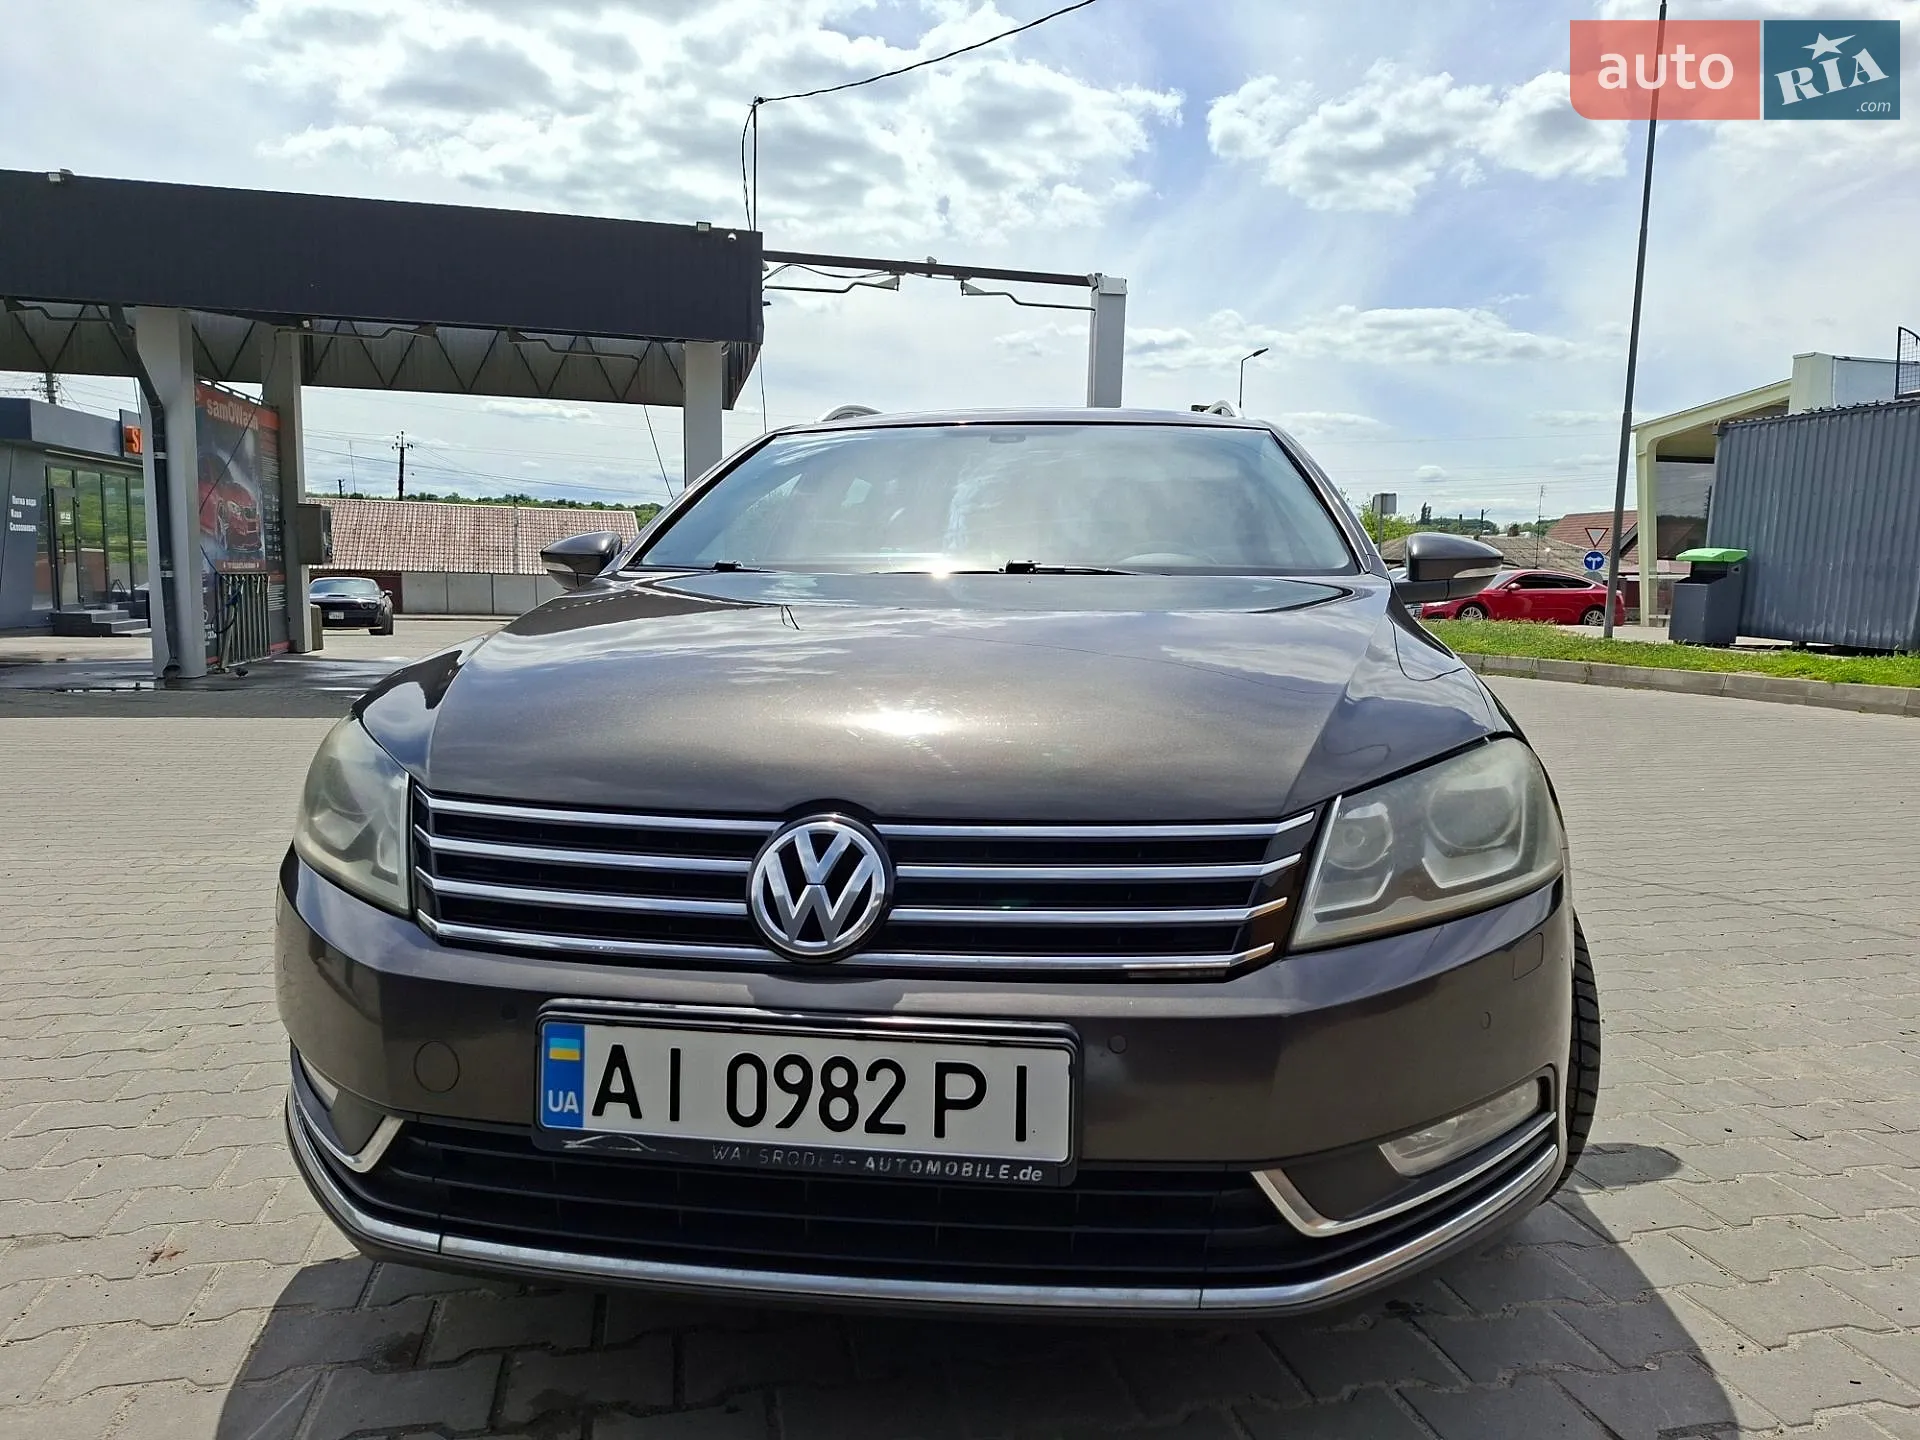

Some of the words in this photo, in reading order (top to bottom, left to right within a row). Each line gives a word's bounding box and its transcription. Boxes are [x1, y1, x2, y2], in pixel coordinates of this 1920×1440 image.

[547, 1089, 580, 1115] UA
[591, 1043, 682, 1122] AI
[725, 1051, 907, 1136] 0982
[932, 1060, 1028, 1143] PI
